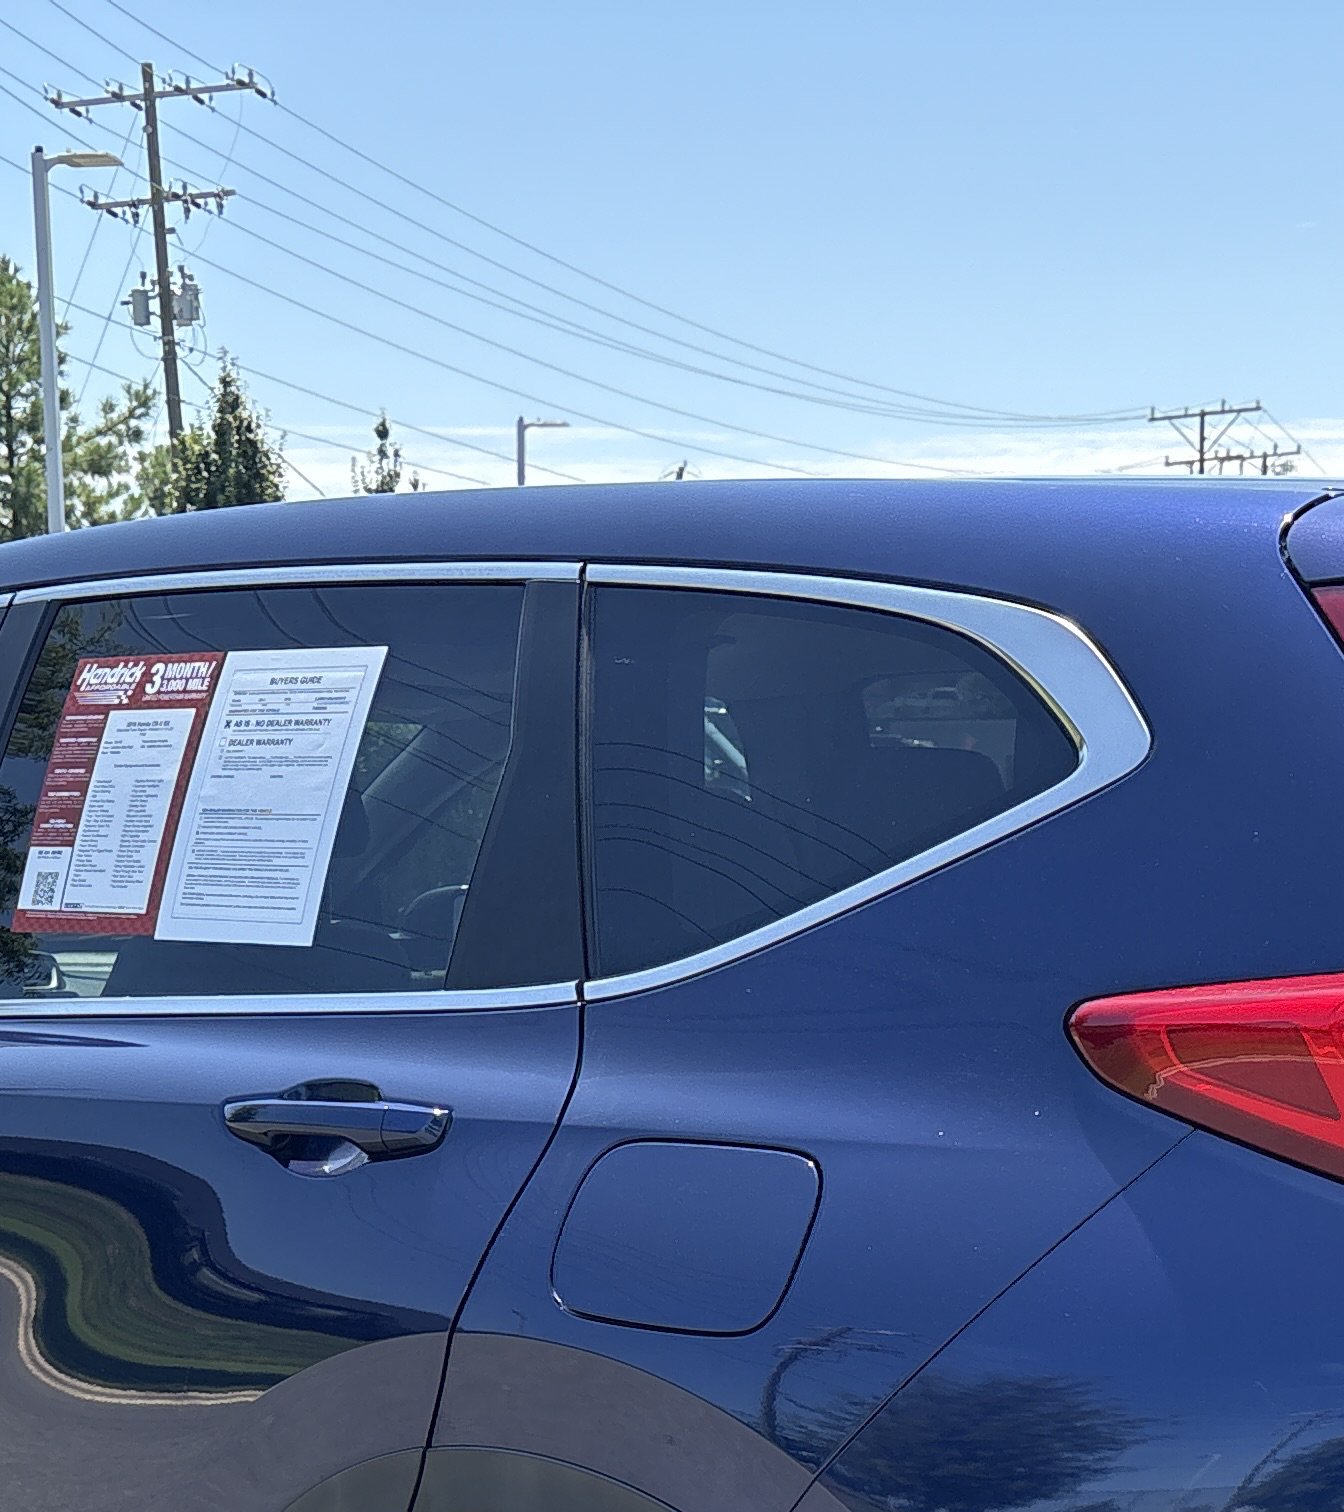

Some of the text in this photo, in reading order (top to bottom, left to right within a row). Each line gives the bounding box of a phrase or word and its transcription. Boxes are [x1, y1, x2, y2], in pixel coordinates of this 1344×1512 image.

[76, 661, 147, 691] Hendrick
[145, 662, 166, 694] 3
[269, 675, 324, 686] BUYERS GUIDE
[185, 677, 211, 691] MILE
[233, 719, 243, 728] AS
[243, 719, 251, 727] IS
[254, 719, 265, 727] NO
[265, 718, 293, 727] DEALER
[293, 717, 333, 727] WARRANTY
[227, 738, 294, 747] DEALER WARRANTY
